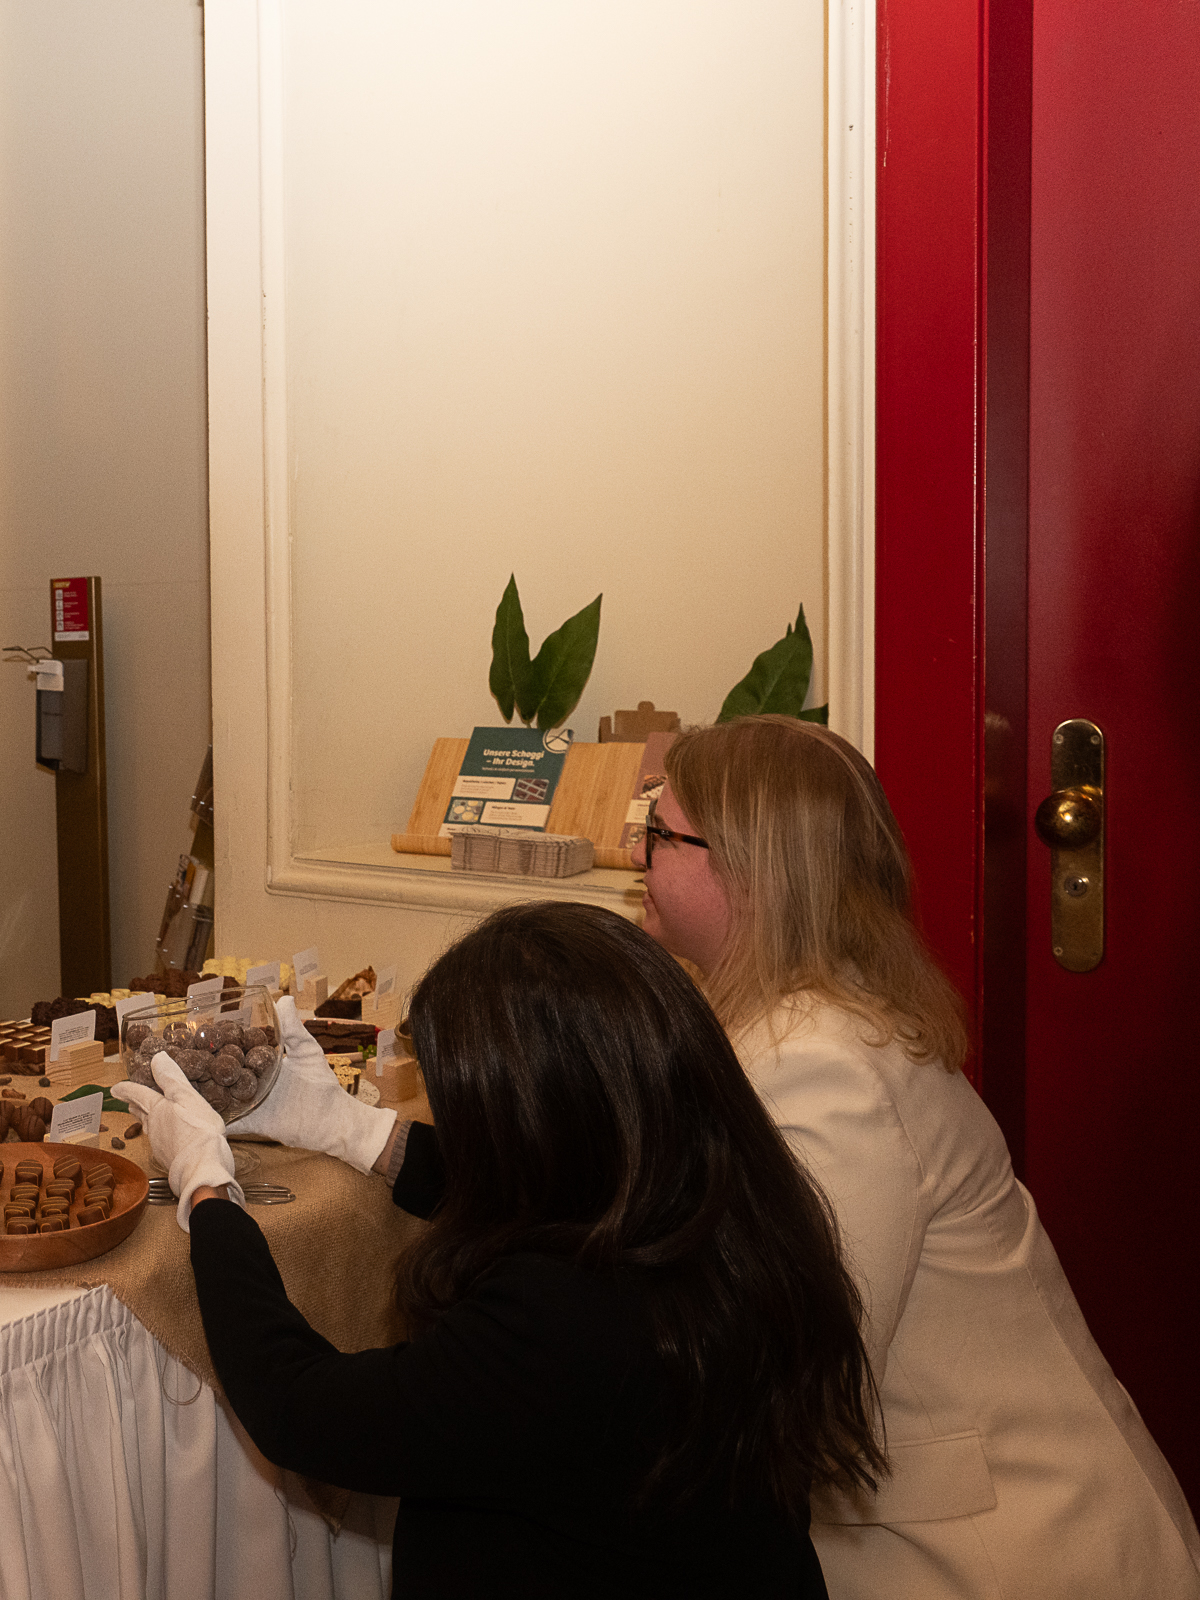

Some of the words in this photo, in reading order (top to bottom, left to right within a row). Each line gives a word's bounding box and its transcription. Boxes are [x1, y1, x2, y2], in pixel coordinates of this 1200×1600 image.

[483, 749, 511, 757] Unsere
[511, 750, 545, 760] Schoggi
[492, 757, 505, 765] Ihr
[505, 758, 535, 768] Design.
